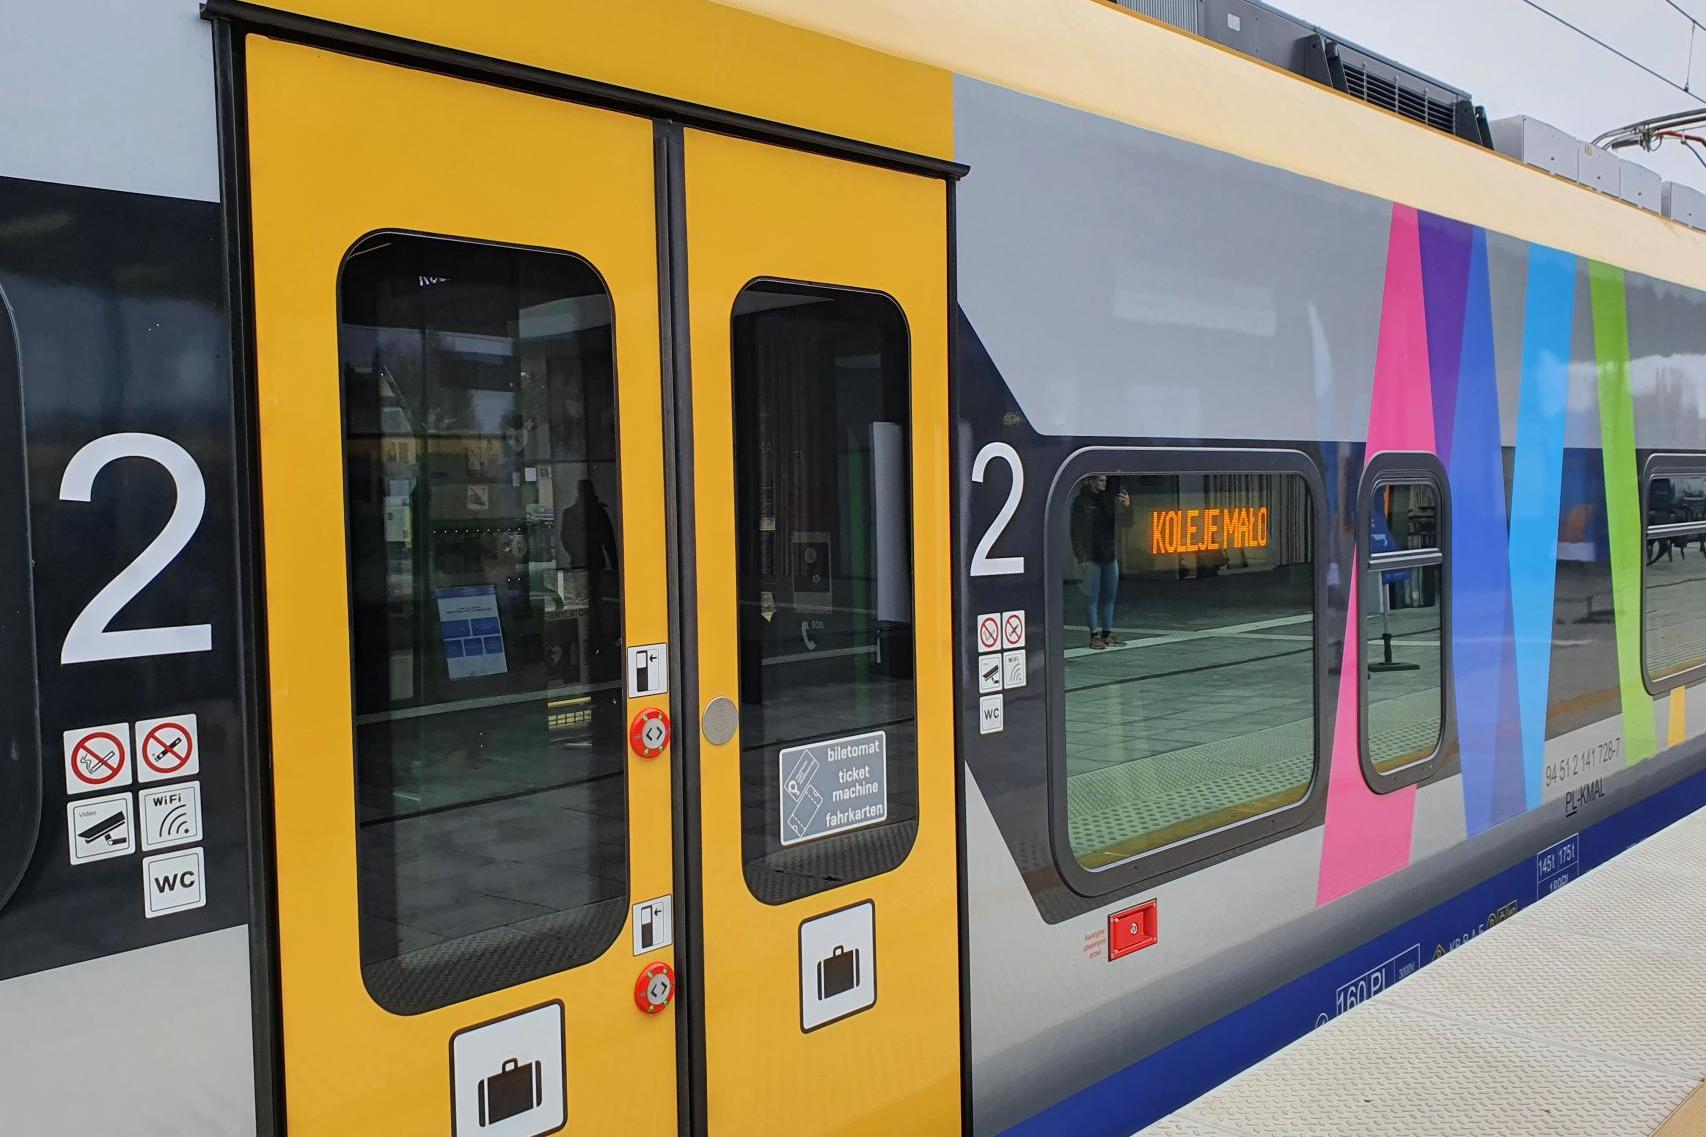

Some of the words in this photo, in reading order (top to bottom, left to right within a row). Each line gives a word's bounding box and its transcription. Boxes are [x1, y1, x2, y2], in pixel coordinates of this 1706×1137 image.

[970, 441, 1025, 576] 2
[1152, 508, 1219, 554] KOLEJE
[59, 432, 212, 664] 2
[984, 707, 1000, 720] WC
[827, 740, 880, 762] biletomat
[838, 765, 870, 783] ticket
[1545, 763, 1557, 787] 94
[1560, 757, 1570, 781] 51
[1573, 754, 1579, 776] 2
[1582, 748, 1595, 772] 141
[153, 793, 182, 807] WiFi
[832, 781, 879, 802] machine
[1565, 776, 1605, 814] PL-KMAL
[825, 803, 883, 828] fahrkarten
[154, 870, 195, 894] WC
